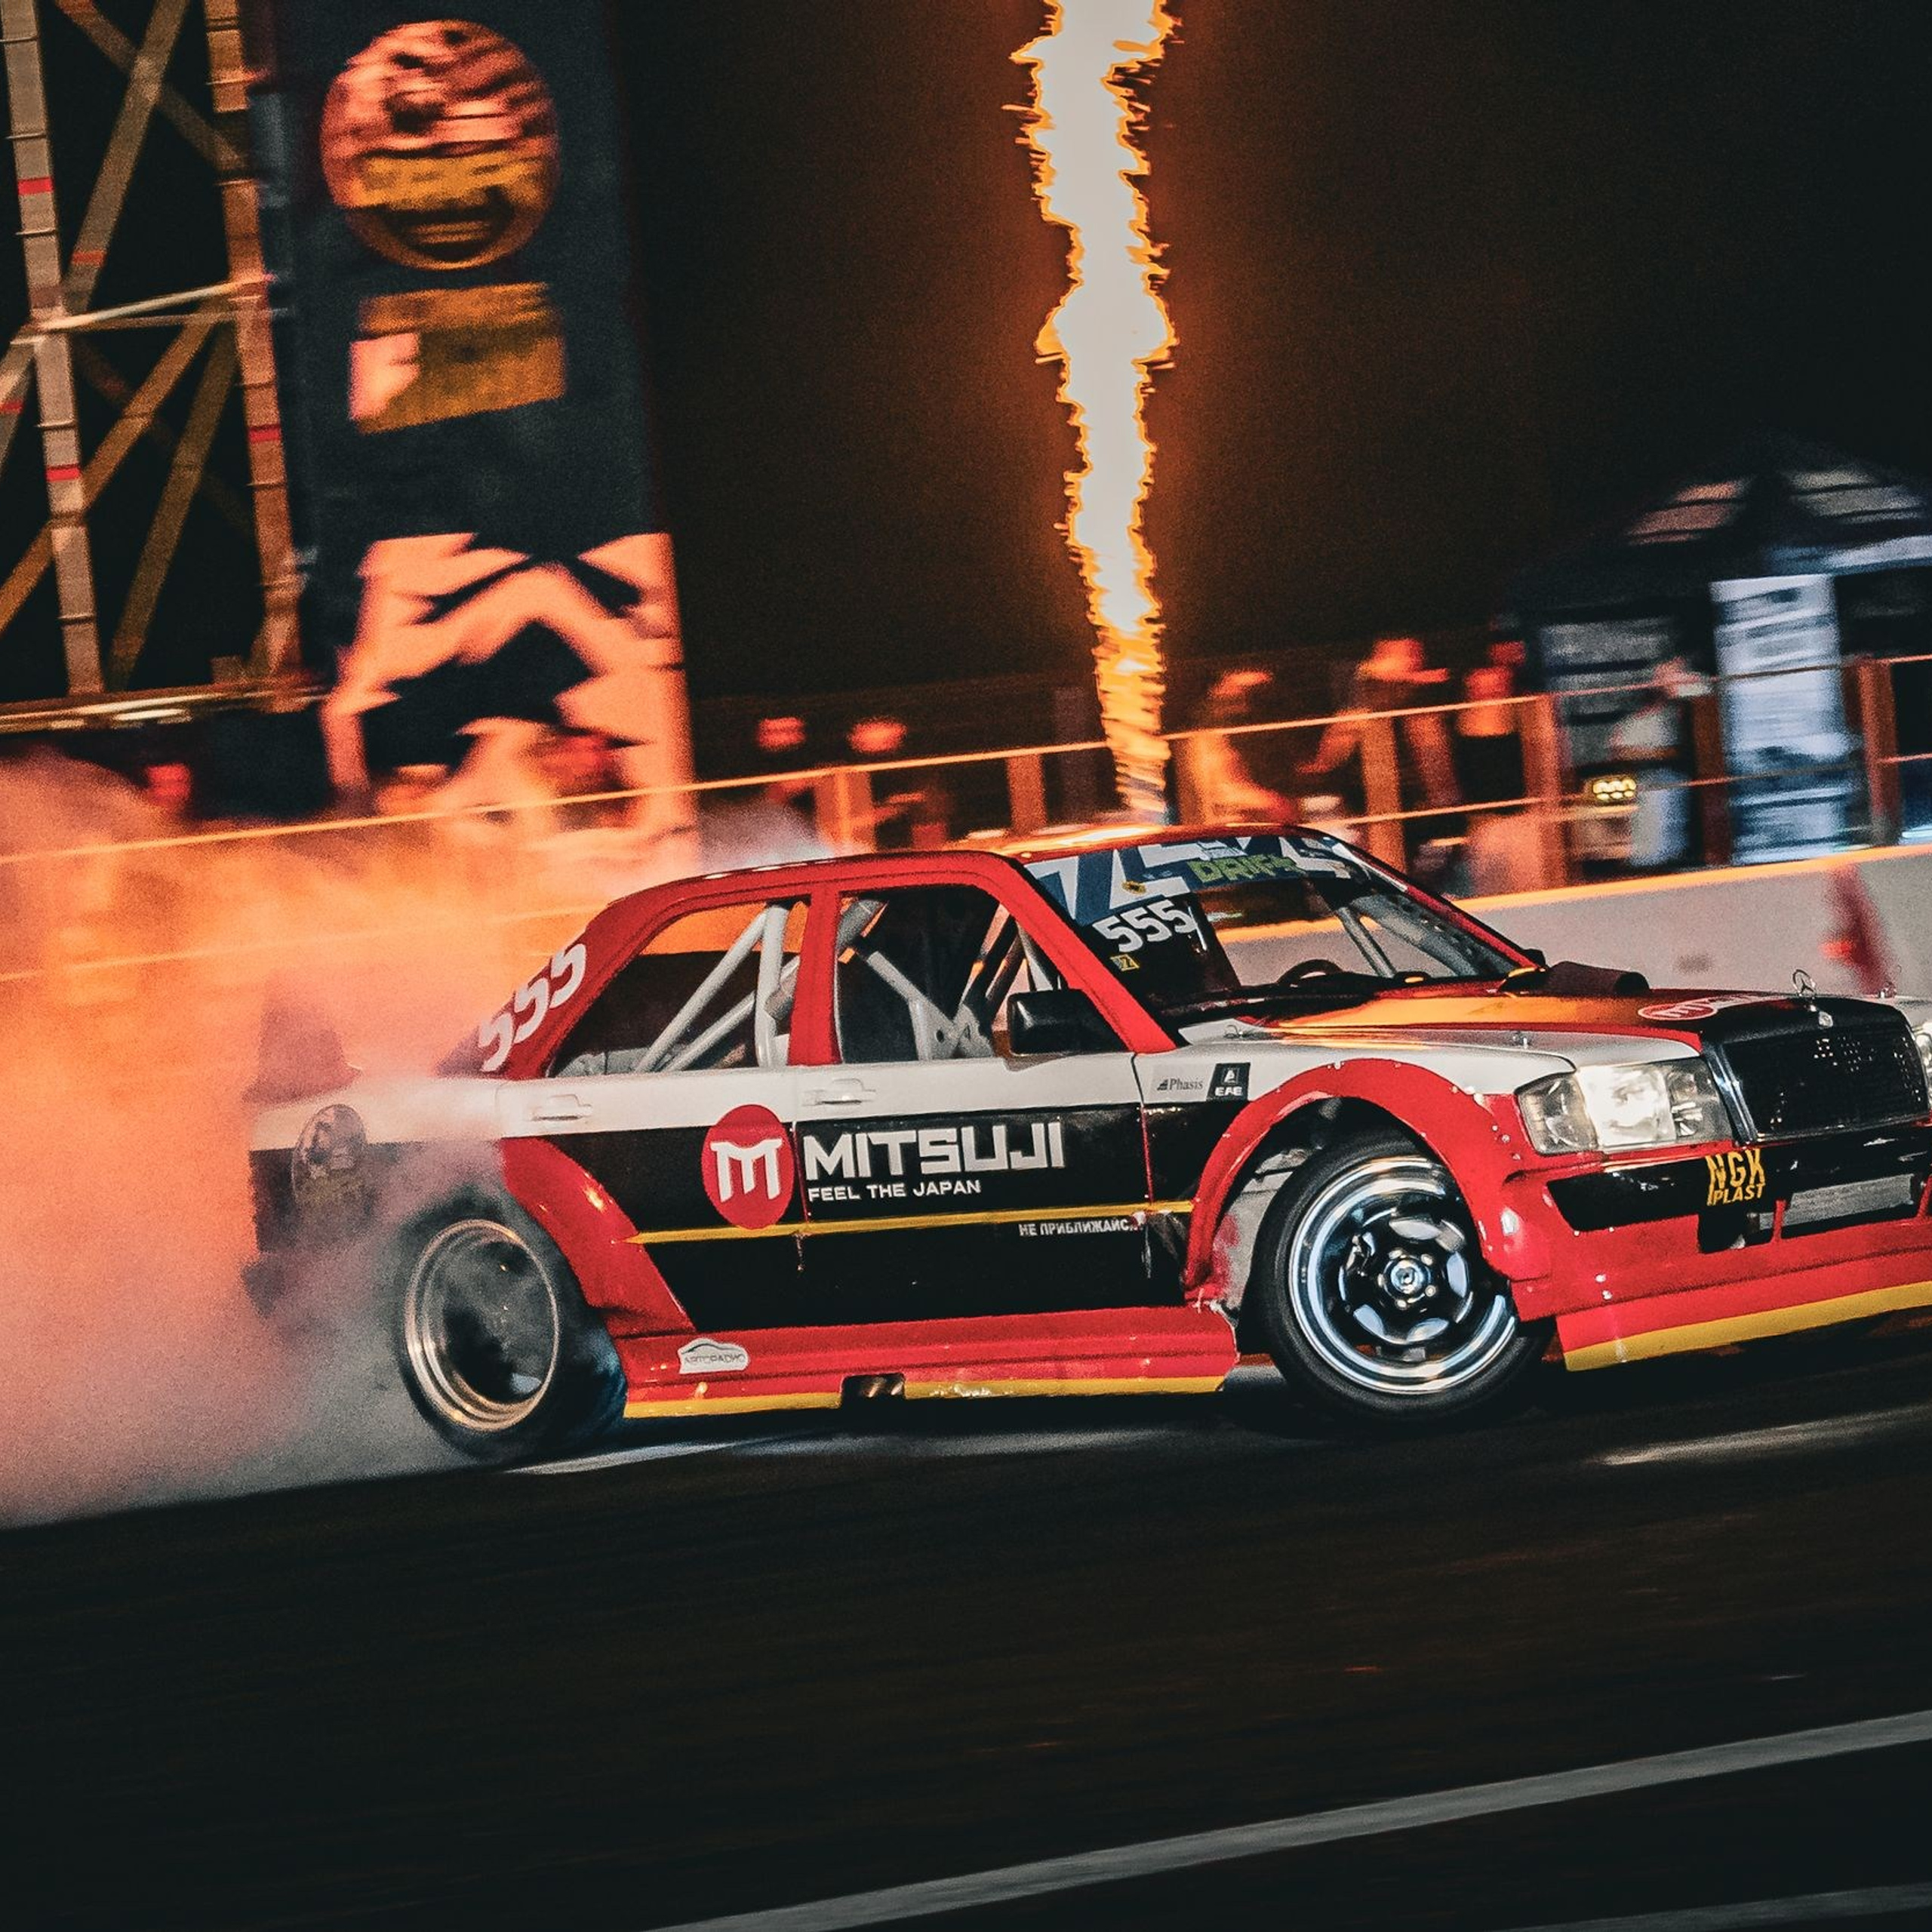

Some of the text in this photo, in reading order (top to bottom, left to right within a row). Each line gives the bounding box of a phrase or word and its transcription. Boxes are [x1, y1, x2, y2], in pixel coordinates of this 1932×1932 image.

[1092, 899, 1197, 952] 555
[478, 943, 586, 1072] 555
[1169, 1078, 1204, 1091] Phasis
[802, 1121, 1065, 1180] MITSUJI
[808, 1179, 981, 1202] FEEL THE JAPAN
[1705, 1148, 1765, 1206] NGK
[1712, 1182, 1766, 1205] PLAST
[1019, 1217, 1143, 1236] НЕ ПРИБЛИЖАЙС
